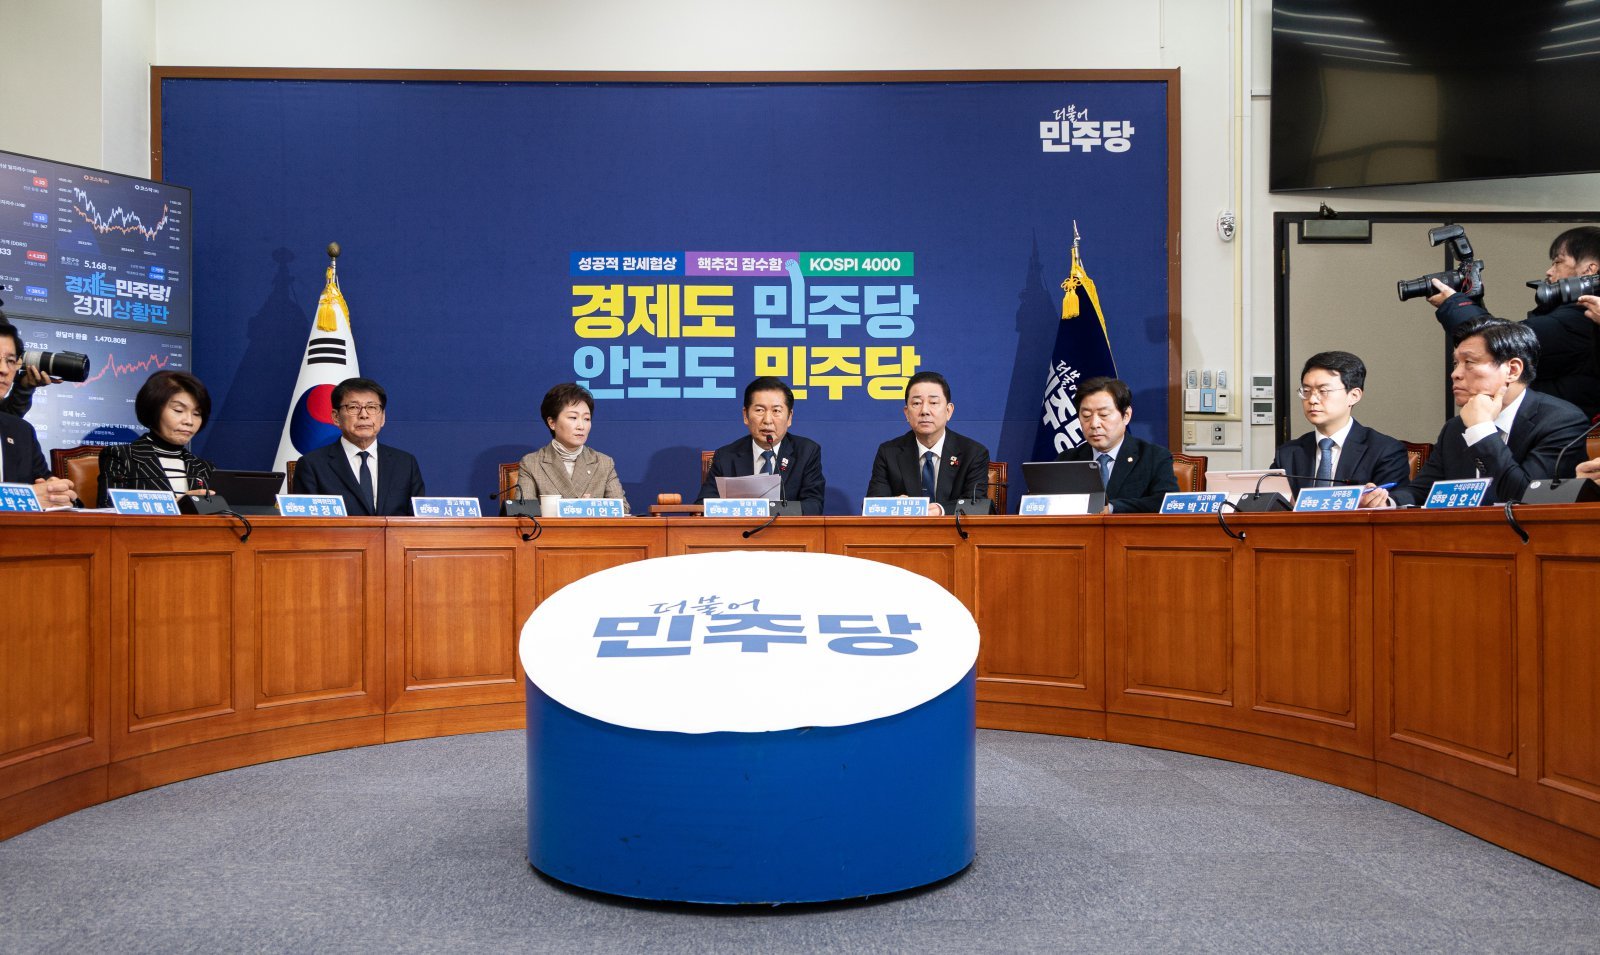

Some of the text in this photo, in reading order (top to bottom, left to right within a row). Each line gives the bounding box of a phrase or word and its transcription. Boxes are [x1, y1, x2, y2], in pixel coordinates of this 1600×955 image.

[1053, 104, 1088, 124] 더불어
[1040, 121, 1135, 152] 민주당
[578, 257, 677, 271] 성공적 관세협상
[697, 257, 782, 271] 핵추진 잠수함
[809, 257, 901, 271] KOSPI 4000
[73, 295, 169, 325] 경제 상황판
[572, 284, 920, 339] 경제도 민주당
[573, 346, 921, 400] 안보도 민주당
[649, 595, 760, 616] 더불어
[593, 613, 923, 659] 민주당
